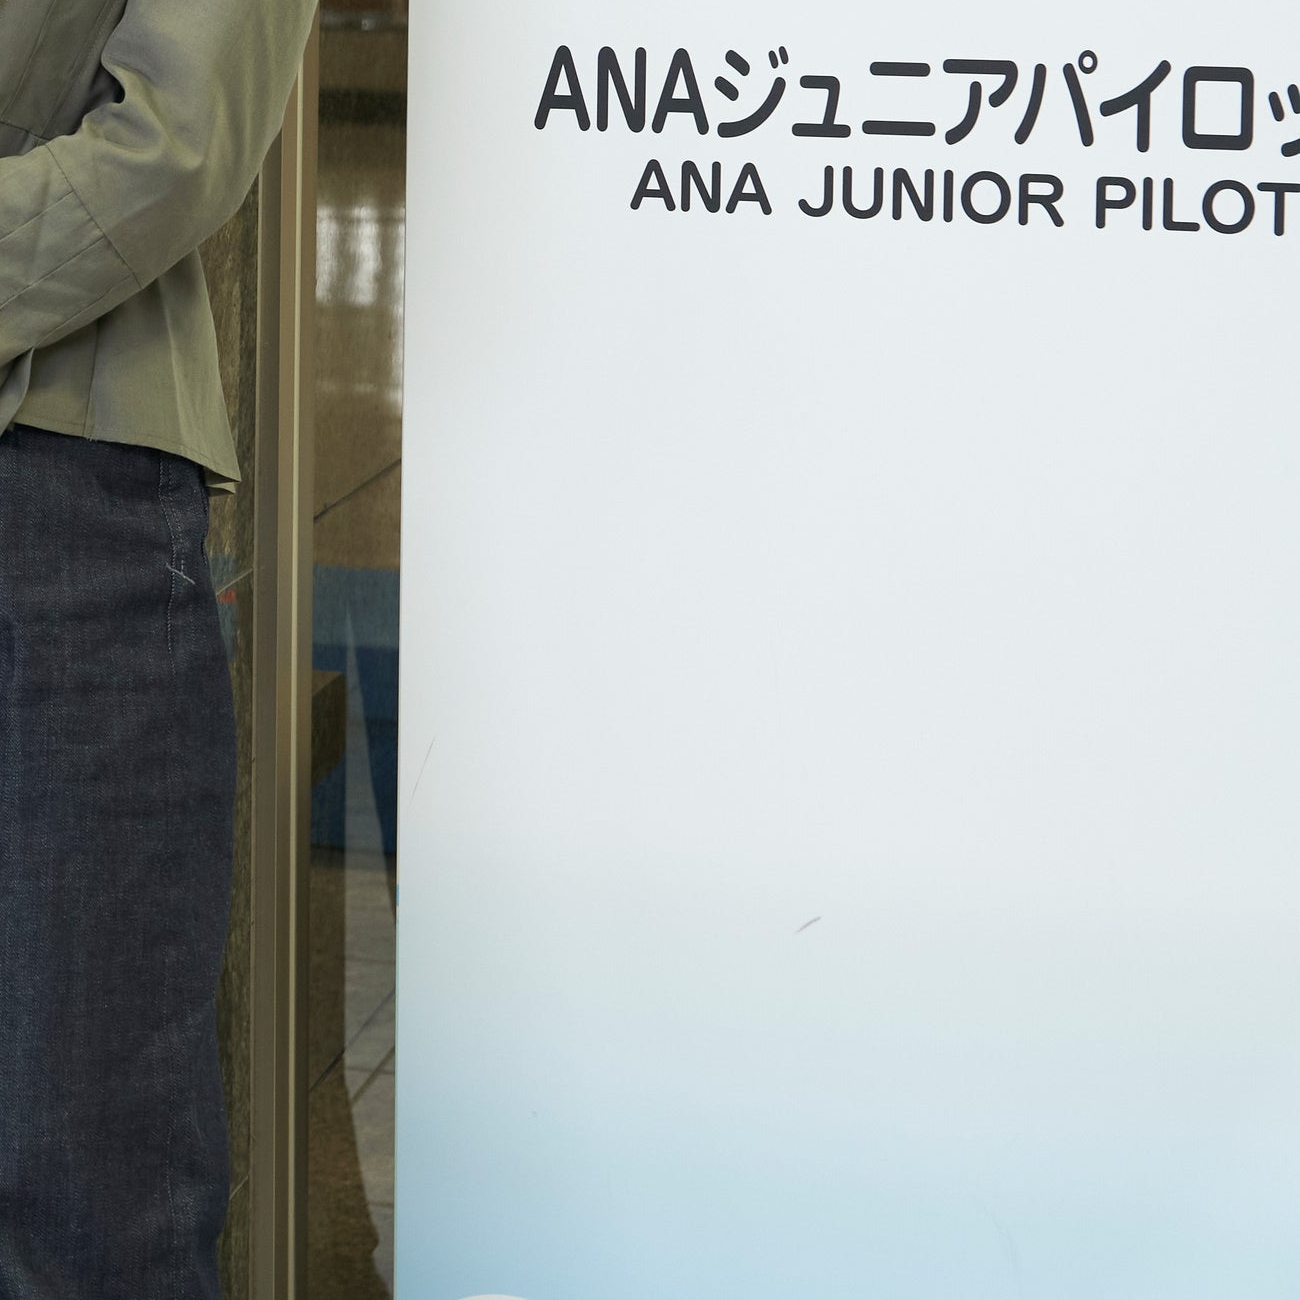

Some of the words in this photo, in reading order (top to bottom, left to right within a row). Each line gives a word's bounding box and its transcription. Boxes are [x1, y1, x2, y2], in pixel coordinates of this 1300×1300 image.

[630, 159, 773, 216] ANA
[798, 164, 1065, 228] JUNIOR
[1095, 175, 1300, 237] PILOT
